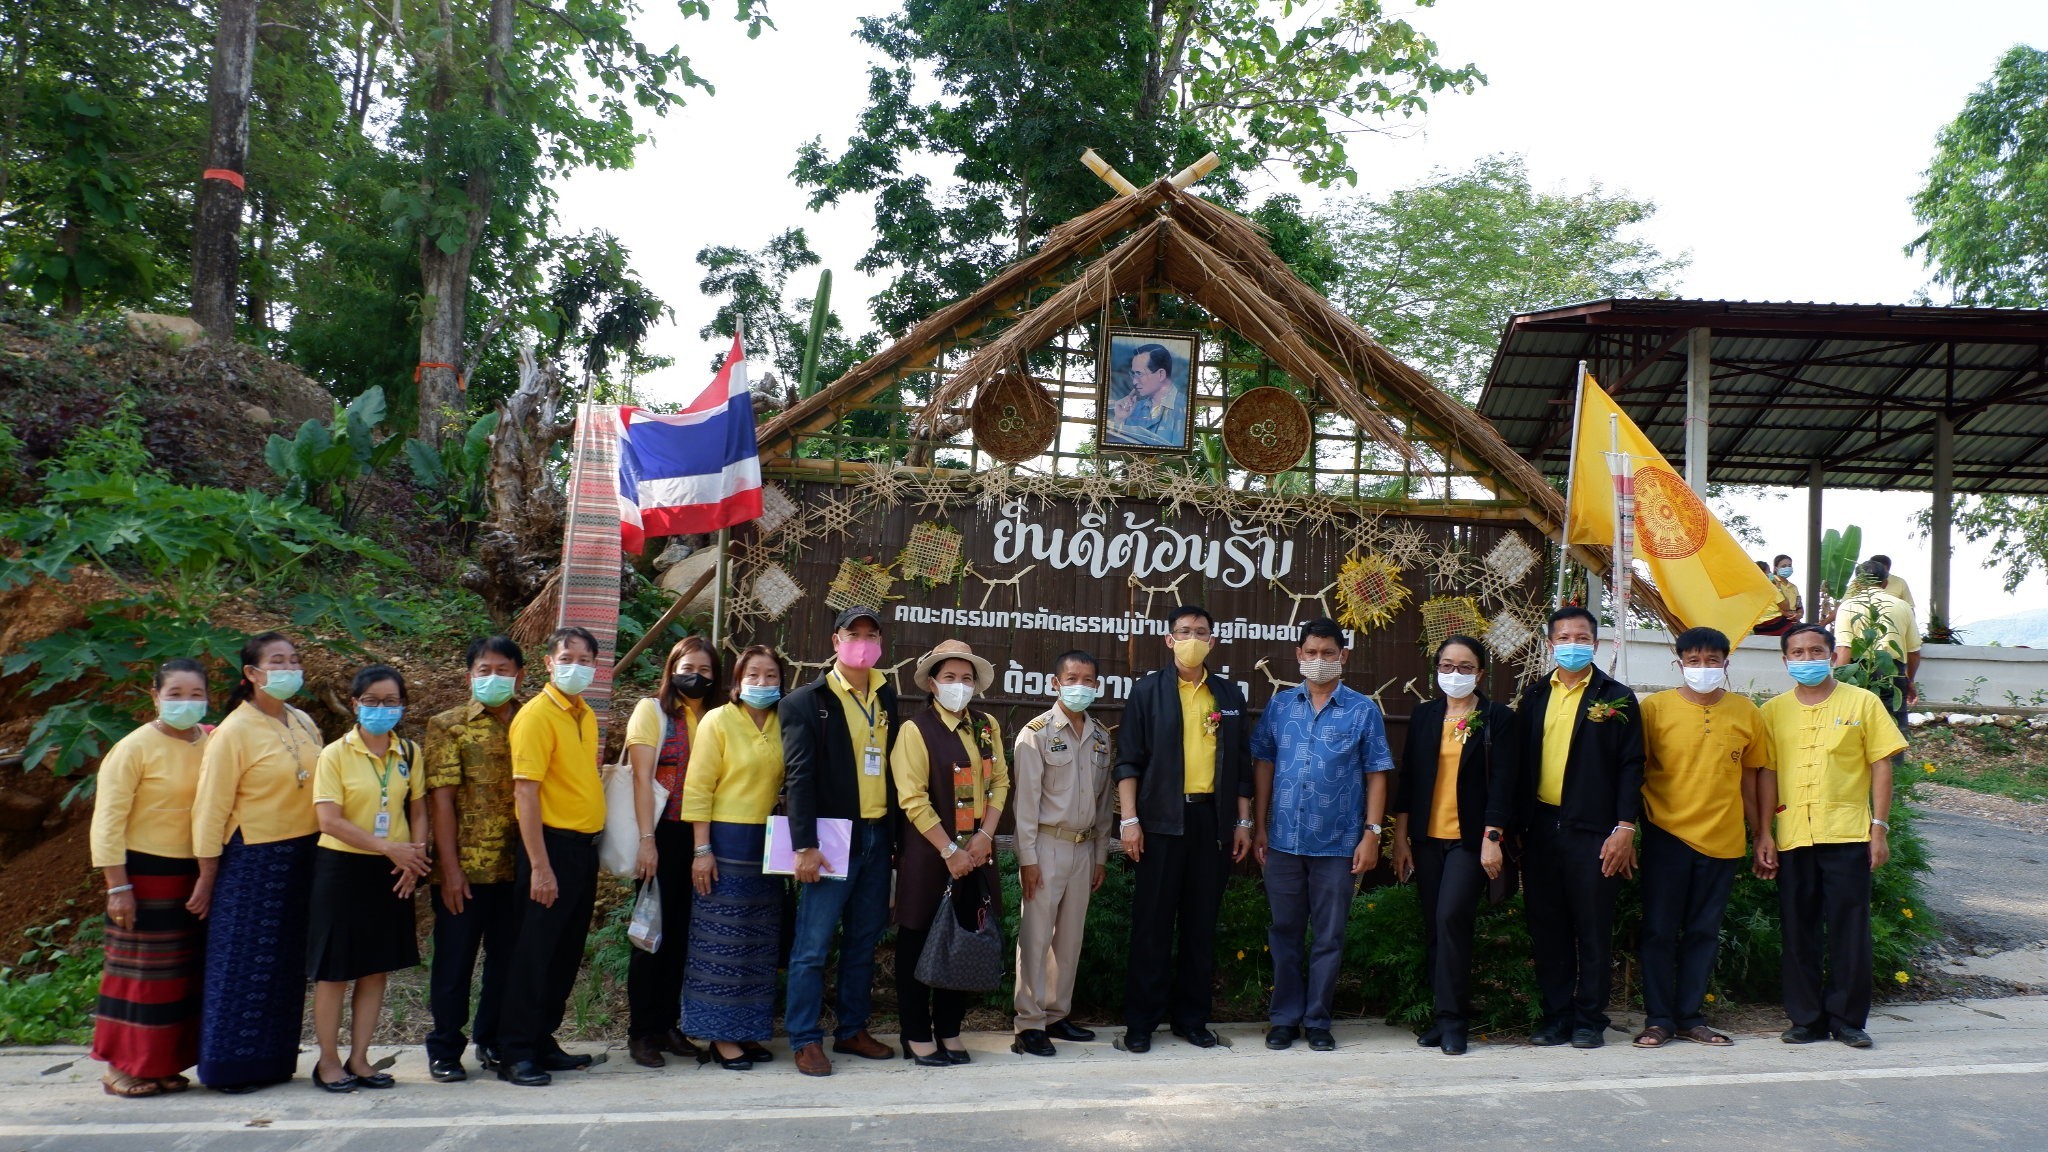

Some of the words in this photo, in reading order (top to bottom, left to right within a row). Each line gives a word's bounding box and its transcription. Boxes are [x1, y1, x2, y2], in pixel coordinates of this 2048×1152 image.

[993, 502, 1294, 588] ยินดีต้อนรับ
